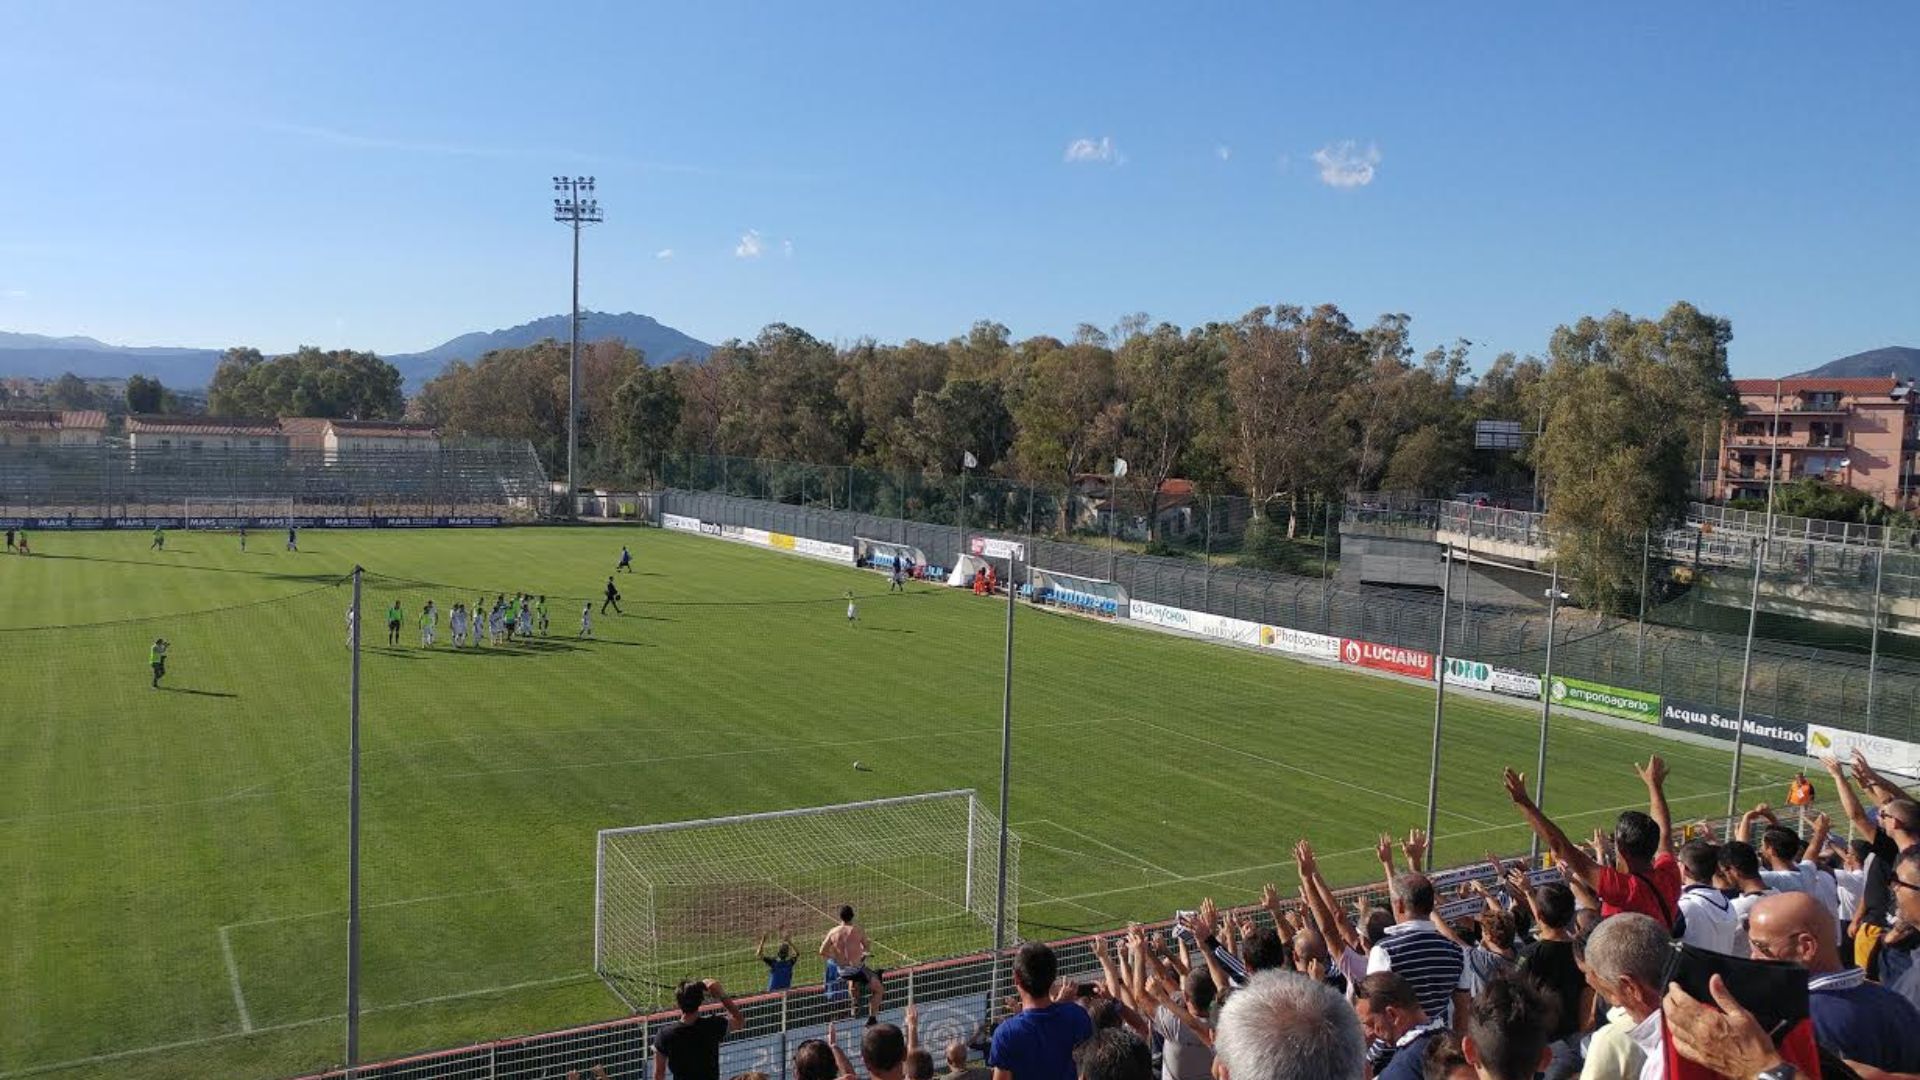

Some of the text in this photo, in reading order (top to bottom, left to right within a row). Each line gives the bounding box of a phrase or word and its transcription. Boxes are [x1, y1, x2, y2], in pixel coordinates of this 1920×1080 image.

[189, 518, 216, 526] MARS
[1363, 644, 1428, 668] LUCIANU
[1664, 705, 1805, 743] Acqua San Martino
